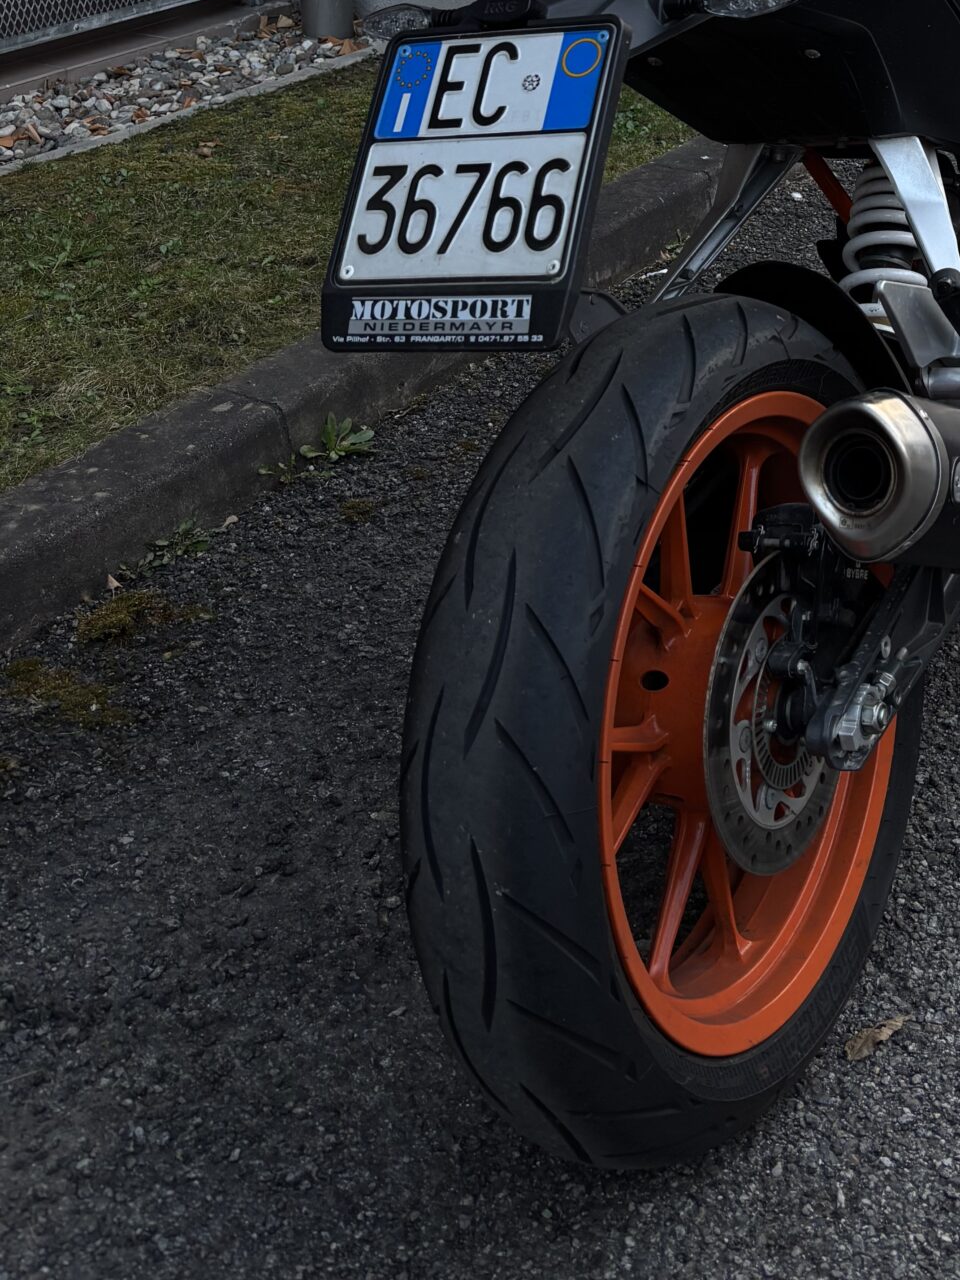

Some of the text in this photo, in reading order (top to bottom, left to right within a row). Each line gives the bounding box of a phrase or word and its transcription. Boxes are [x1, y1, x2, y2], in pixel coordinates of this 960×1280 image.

[427, 41, 519, 130] EC
[393, 92, 411, 133] I
[356, 157, 572, 256] 36766
[350, 297, 530, 321] MOTOSPORT
[332, 335, 345, 343] Via
[363, 321, 514, 332] NIEDERMAYR
